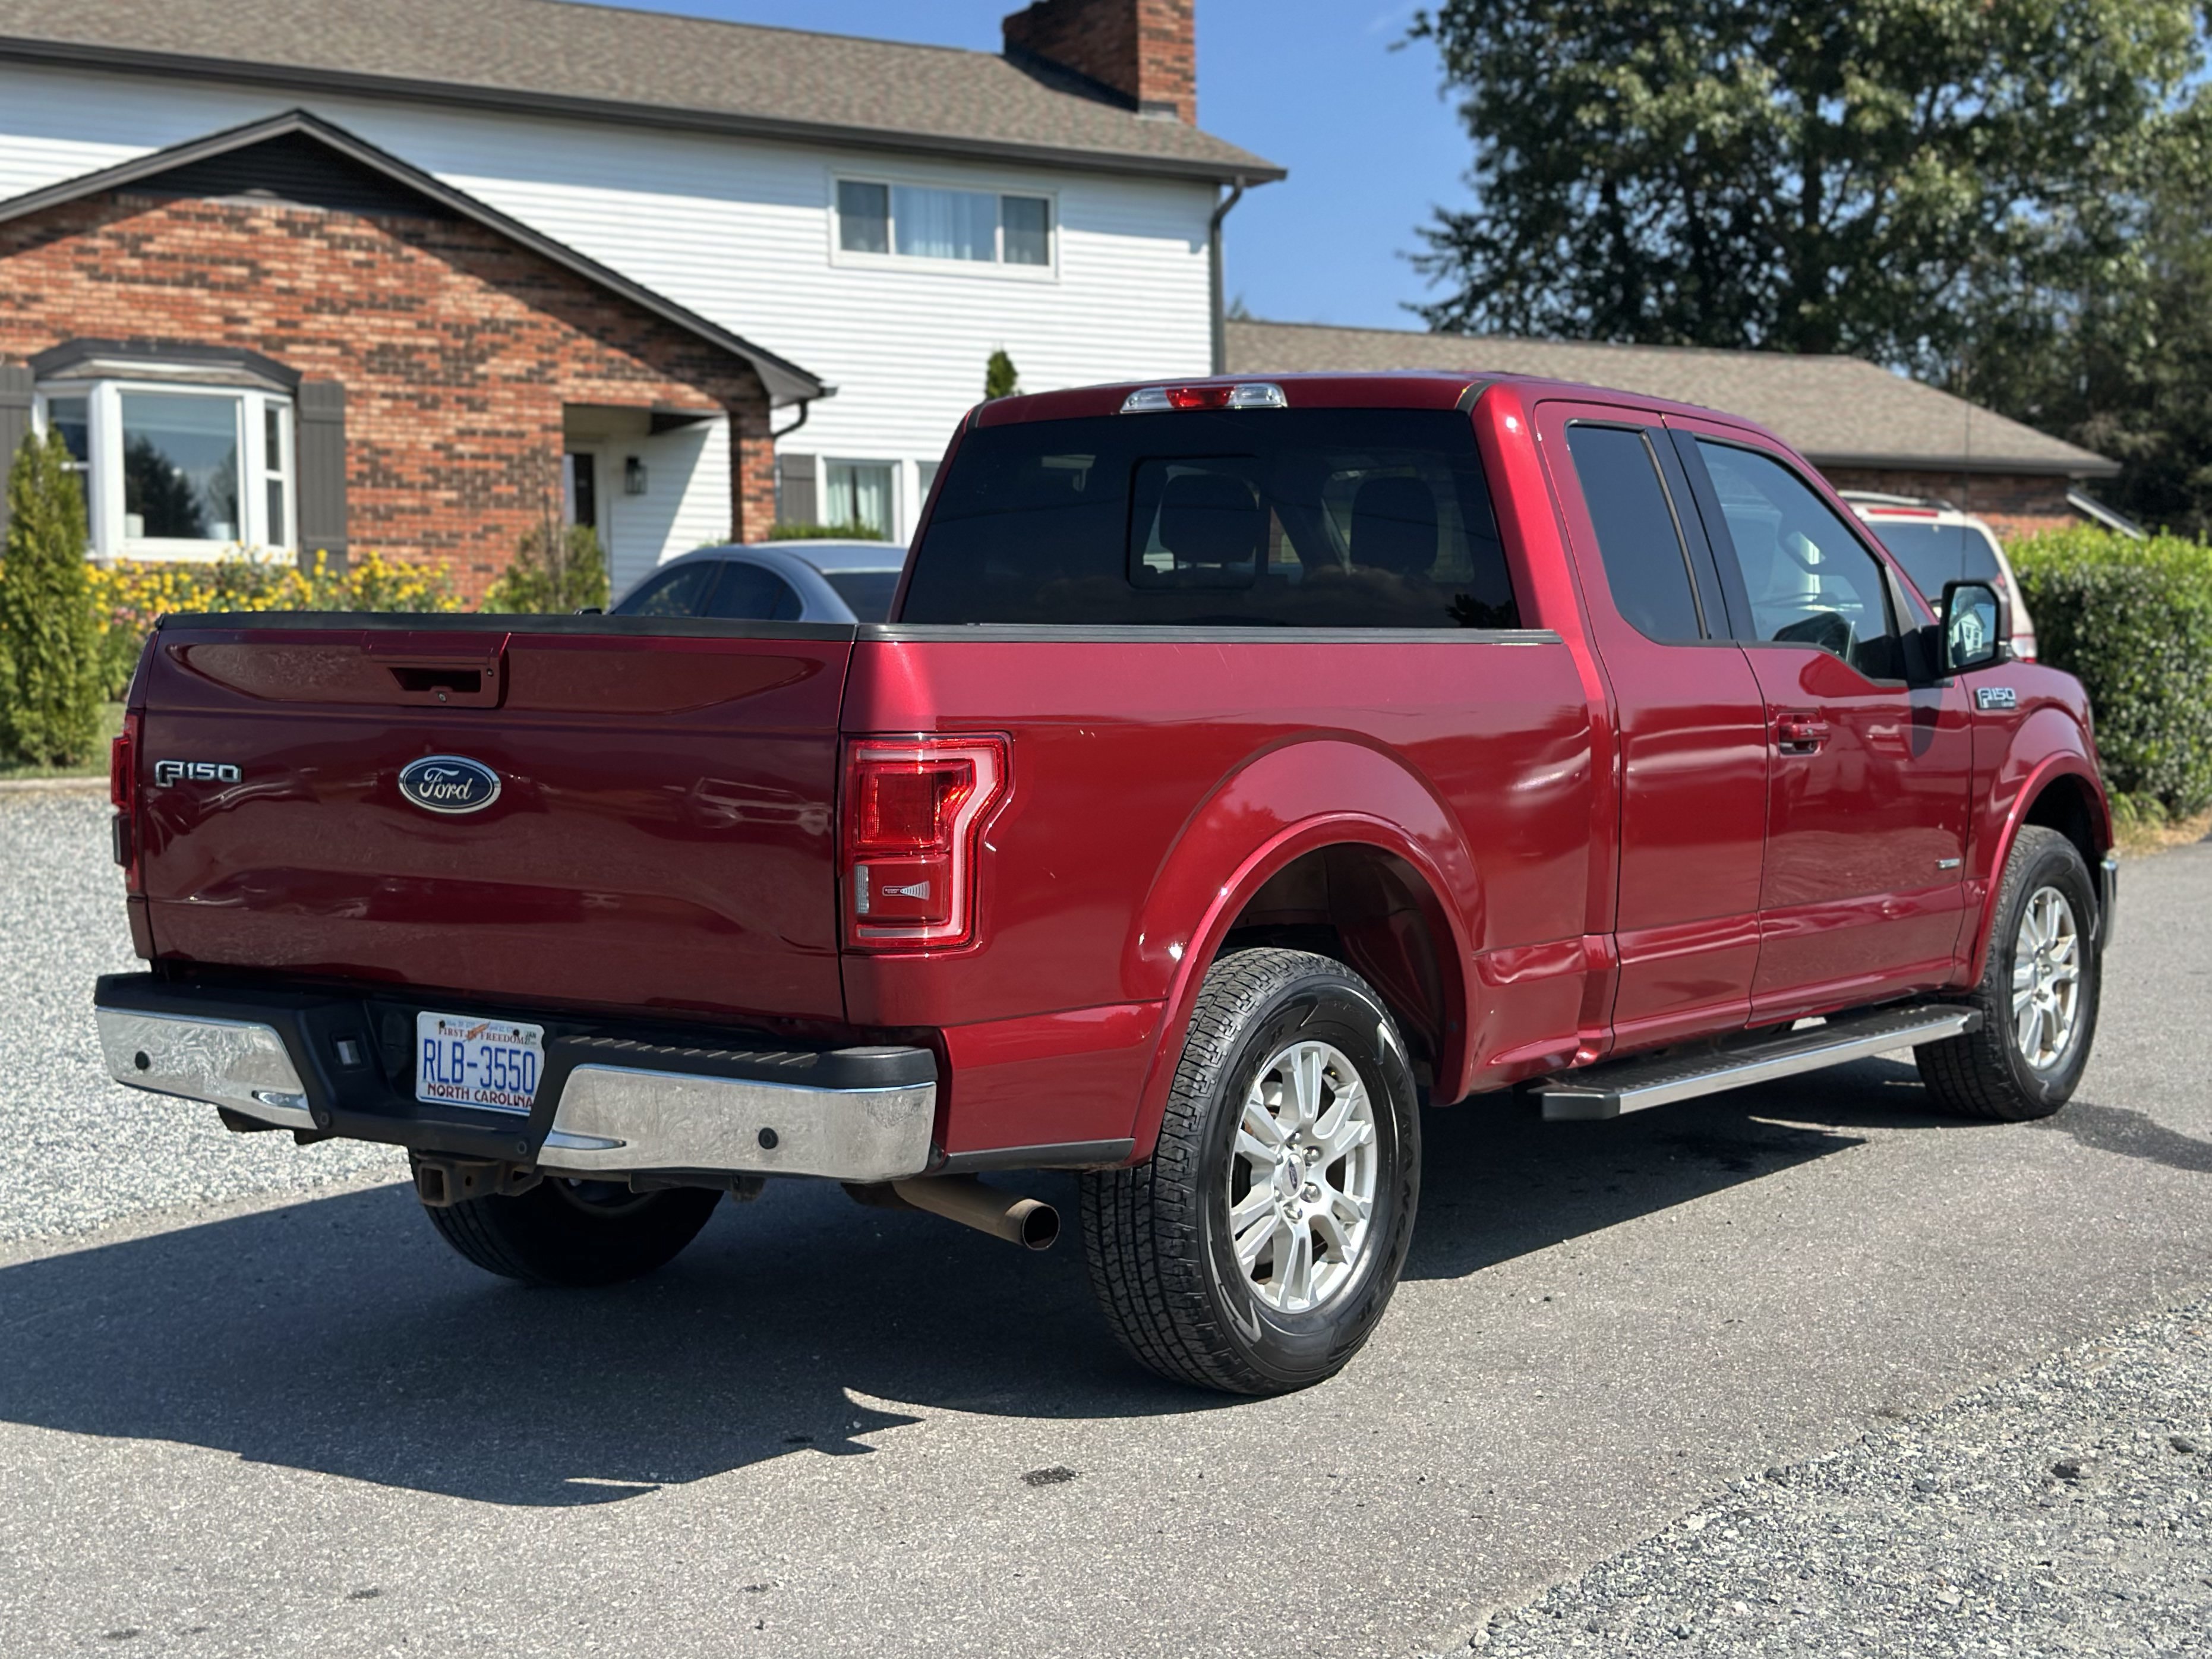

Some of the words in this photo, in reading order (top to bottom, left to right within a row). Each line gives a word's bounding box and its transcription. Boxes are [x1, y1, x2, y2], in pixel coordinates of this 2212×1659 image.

[419, 767, 473, 801] Ford
[438, 1026, 465, 1037] FIRST
[479, 1030, 524, 1045] FREEDOM
[423, 1038, 535, 1095] RLB-3550
[427, 1083, 469, 1100] NORTH
[474, 1089, 534, 1108] CAROLINA
